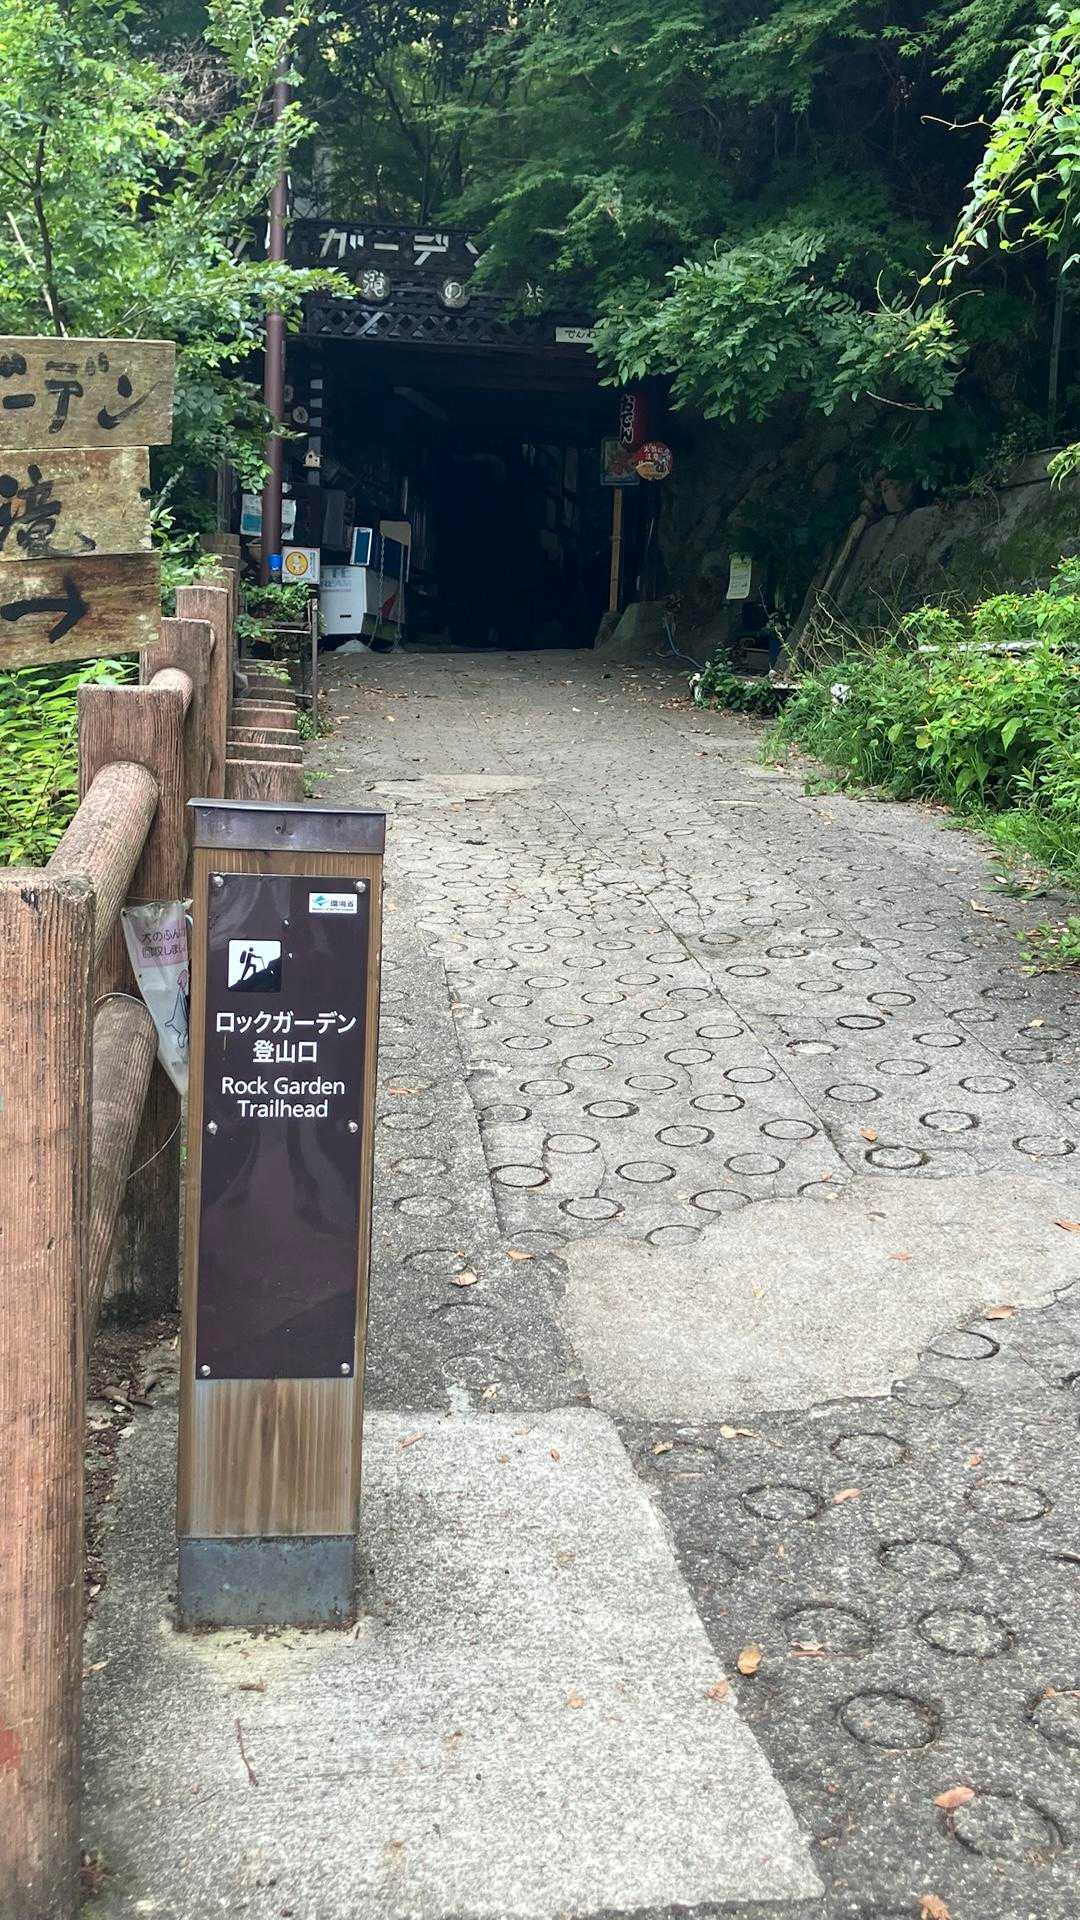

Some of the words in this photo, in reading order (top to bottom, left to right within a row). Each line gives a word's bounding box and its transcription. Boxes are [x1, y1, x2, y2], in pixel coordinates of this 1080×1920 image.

[216, 1011, 357, 1034] ロックガーデン
[252, 1040, 318, 1063] 登山口
[221, 1076, 268, 1095] Rock
[273, 1076, 346, 1095] Garden
[237, 1099, 329, 1118] Trailhead
